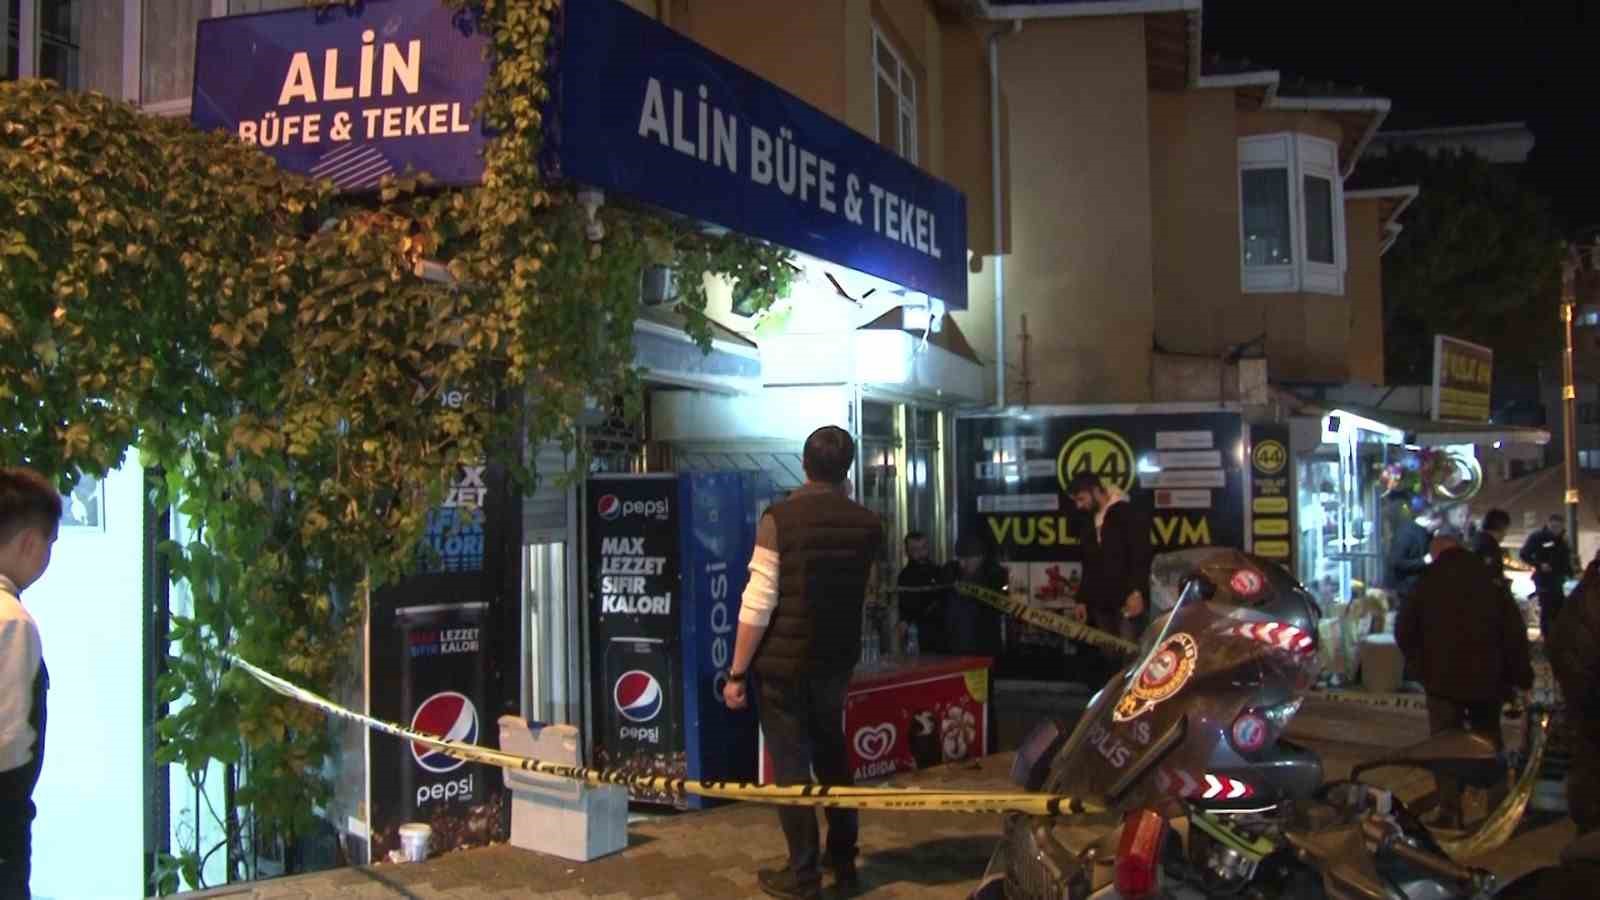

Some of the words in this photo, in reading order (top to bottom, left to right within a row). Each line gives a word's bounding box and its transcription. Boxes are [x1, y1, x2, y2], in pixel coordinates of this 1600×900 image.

[278, 29, 421, 106] ALİN
[238, 112, 321, 147] BÜFE
[329, 112, 352, 142] &
[362, 102, 470, 139] TEKEL
[638, 77, 737, 174] ALİN
[750, 126, 837, 213] BÜFE
[844, 173, 864, 226] &
[869, 183, 941, 259] TEKEL
[1255, 449, 1283, 464] 44
[1071, 451, 1123, 487] 44
[622, 496, 669, 517] pepsi
[987, 516, 1081, 546] VUSL
[601, 537, 645, 555] MAX
[601, 556, 666, 575] LEZZET
[601, 576, 647, 595] SIFIR
[601, 592, 671, 614] KALORİ
[440, 628, 480, 643] LEZZET
[620, 726, 659, 741] pepsi
[416, 774, 474, 808] pepsi
